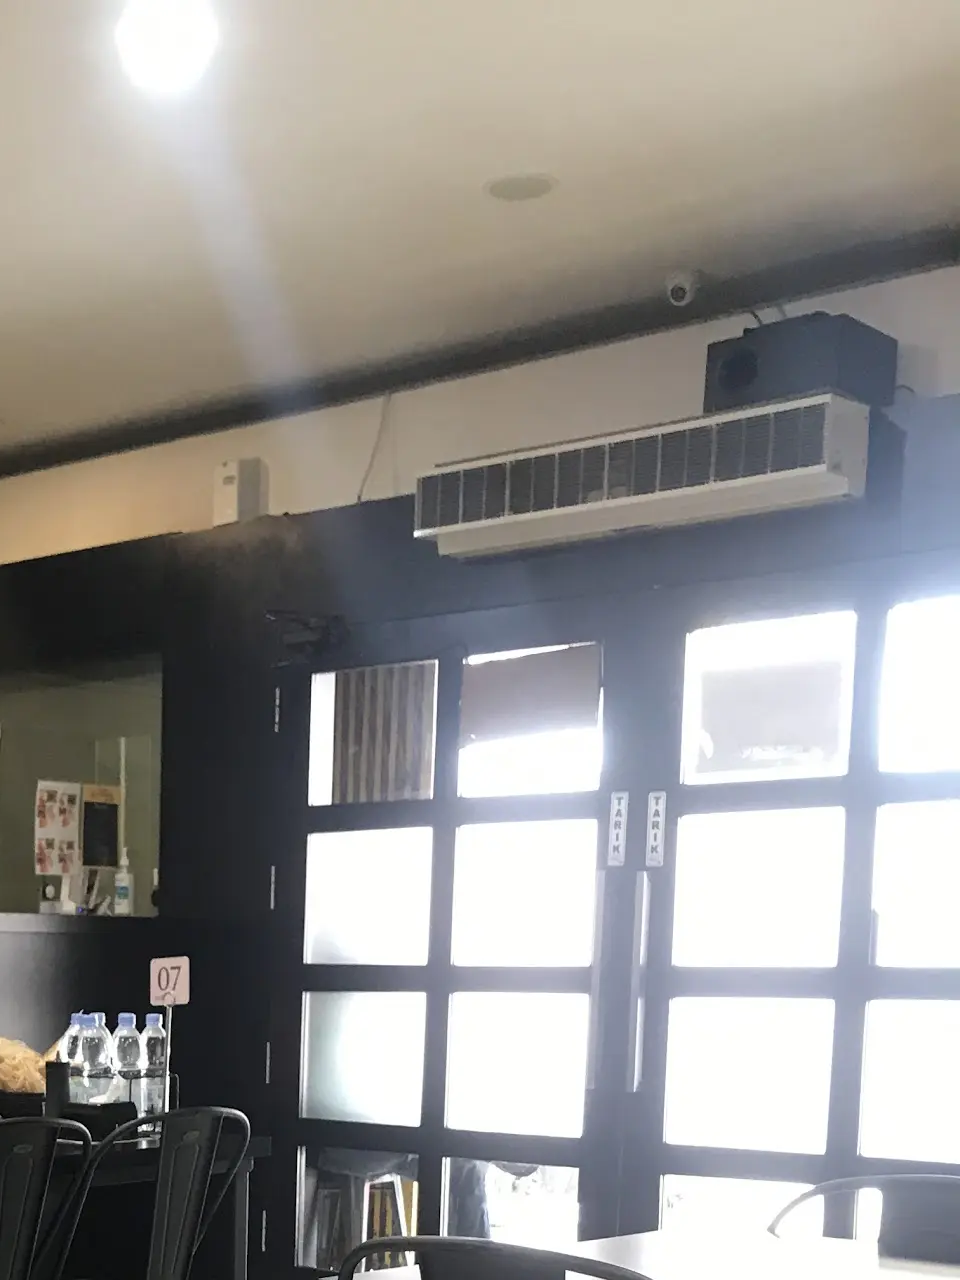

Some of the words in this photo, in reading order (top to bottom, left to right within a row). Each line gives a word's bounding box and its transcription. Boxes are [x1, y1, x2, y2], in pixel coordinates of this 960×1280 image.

[612, 796, 624, 854] TARIK
[650, 796, 661, 854] TARIK
[157, 966, 182, 991] 07
